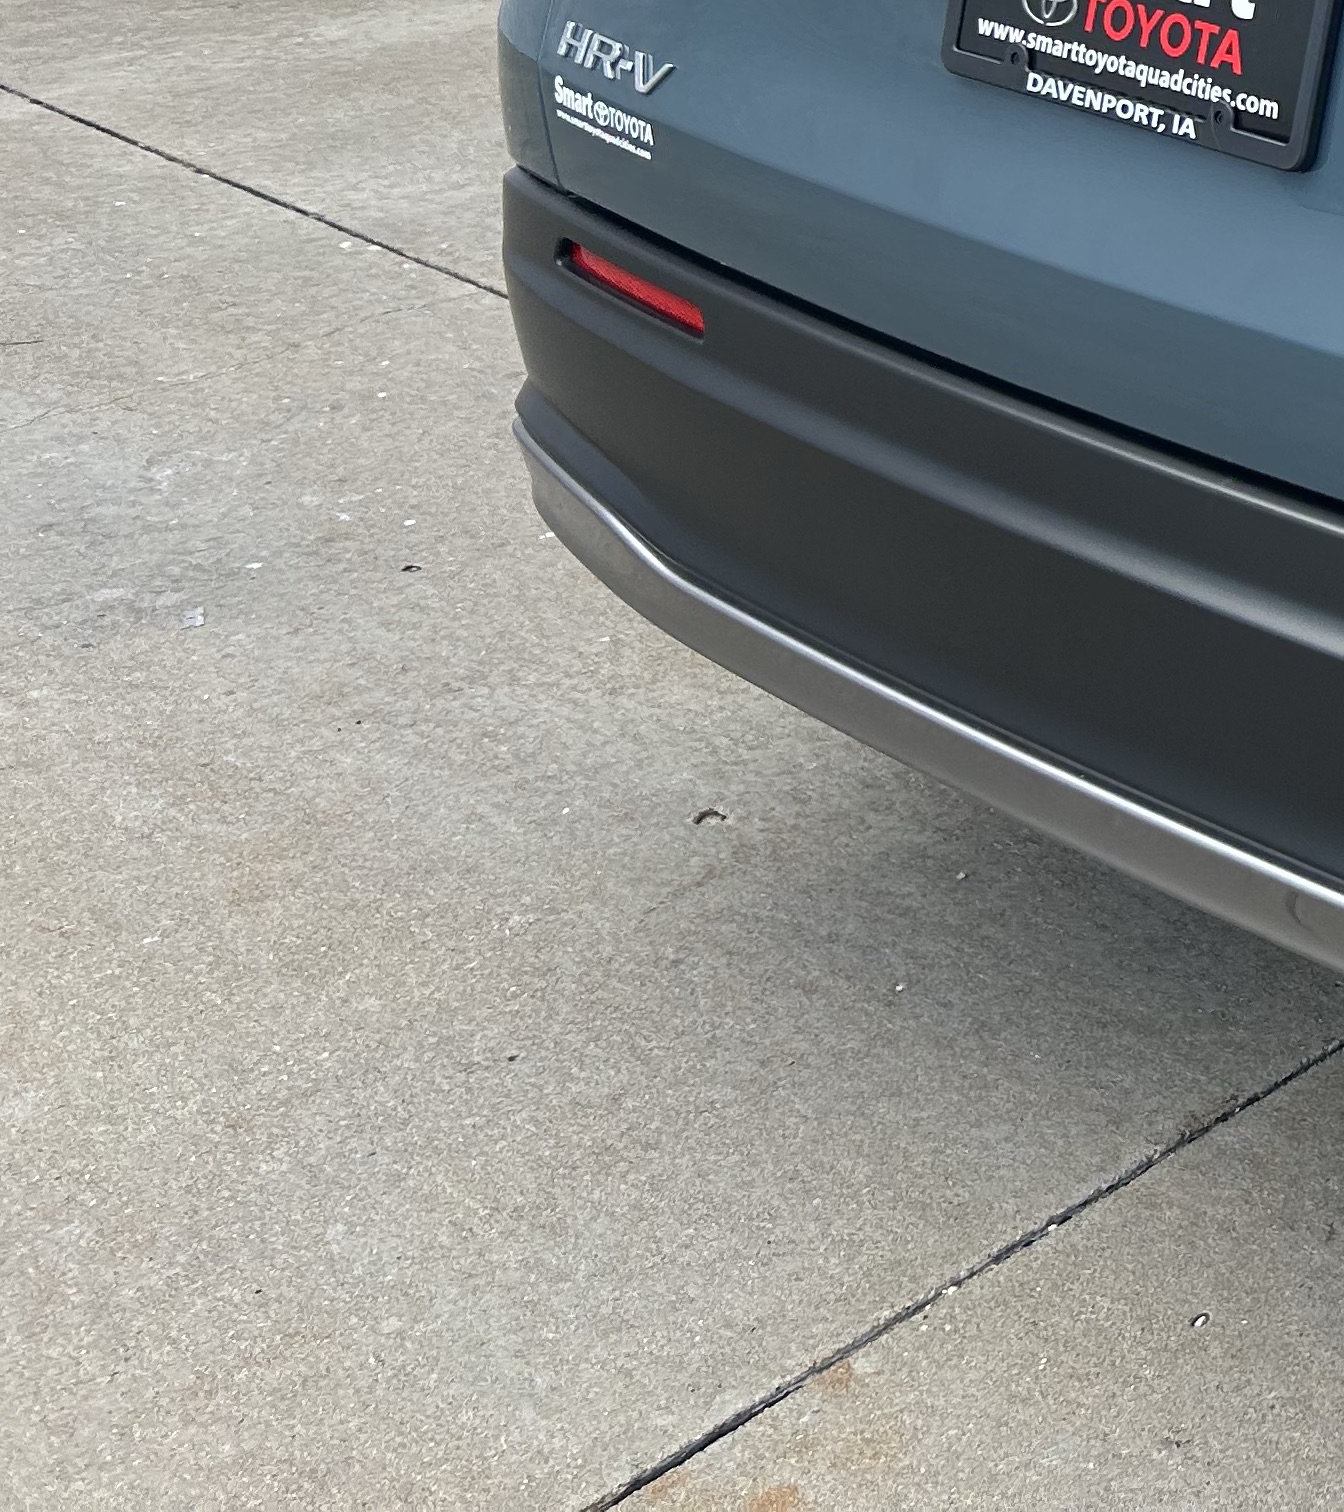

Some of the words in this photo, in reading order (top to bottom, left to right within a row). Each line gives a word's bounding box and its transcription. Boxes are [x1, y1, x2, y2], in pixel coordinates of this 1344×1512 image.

[556, 20, 676, 94] HR-V
[977, 16, 1280, 120] www.smarttoyotaquadcities.com
[554, 74, 594, 120] Smart
[608, 105, 655, 146] TOYOTA
[1025, 72, 1168, 134] DAVENPORT,
[1171, 112, 1198, 140] IA
